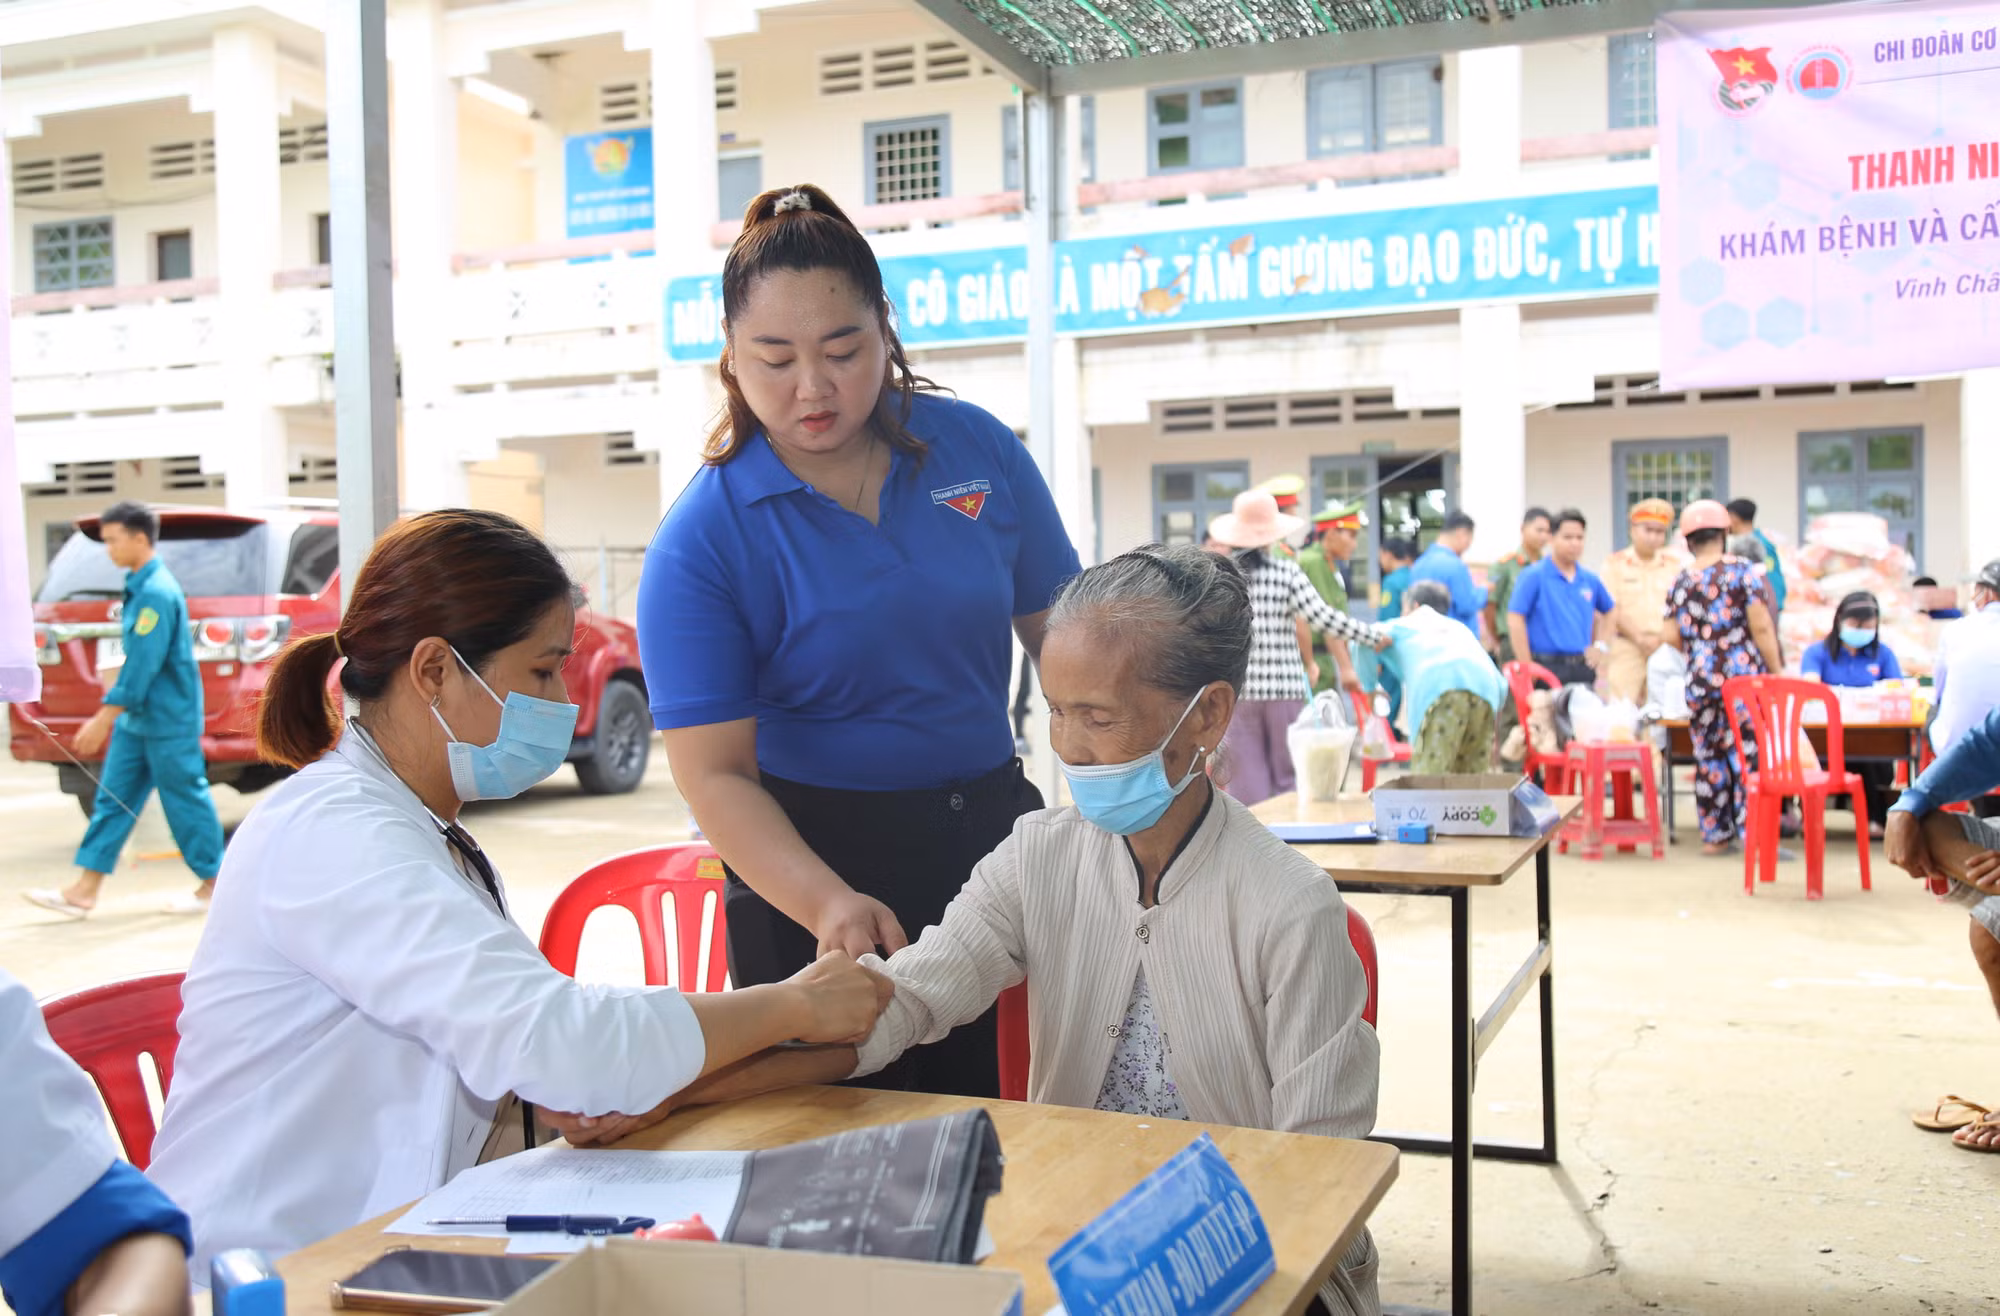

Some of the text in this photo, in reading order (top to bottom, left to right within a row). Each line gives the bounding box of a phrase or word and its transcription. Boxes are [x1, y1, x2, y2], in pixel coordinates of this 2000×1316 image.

[1874, 26, 1997, 63] CHI ĐOÀN CƠ
[1848, 141, 1999, 191] THANH NI
[1720, 221, 1805, 260] KHÁM
[1818, 215, 1897, 258] BỆNH
[1908, 207, 1948, 245] VÀ
[907, 268, 948, 327] CÔ
[958, 260, 1028, 323] GIÁO
[1258, 234, 1373, 298] GƯƠNG
[1384, 229, 1460, 298] ĐẠO
[1473, 213, 1561, 284] ĐỨC,
[1575, 206, 1627, 284] TỰ
[1895, 277, 1946, 299] Vĩnh
[1442, 810, 1480, 821] COPY
